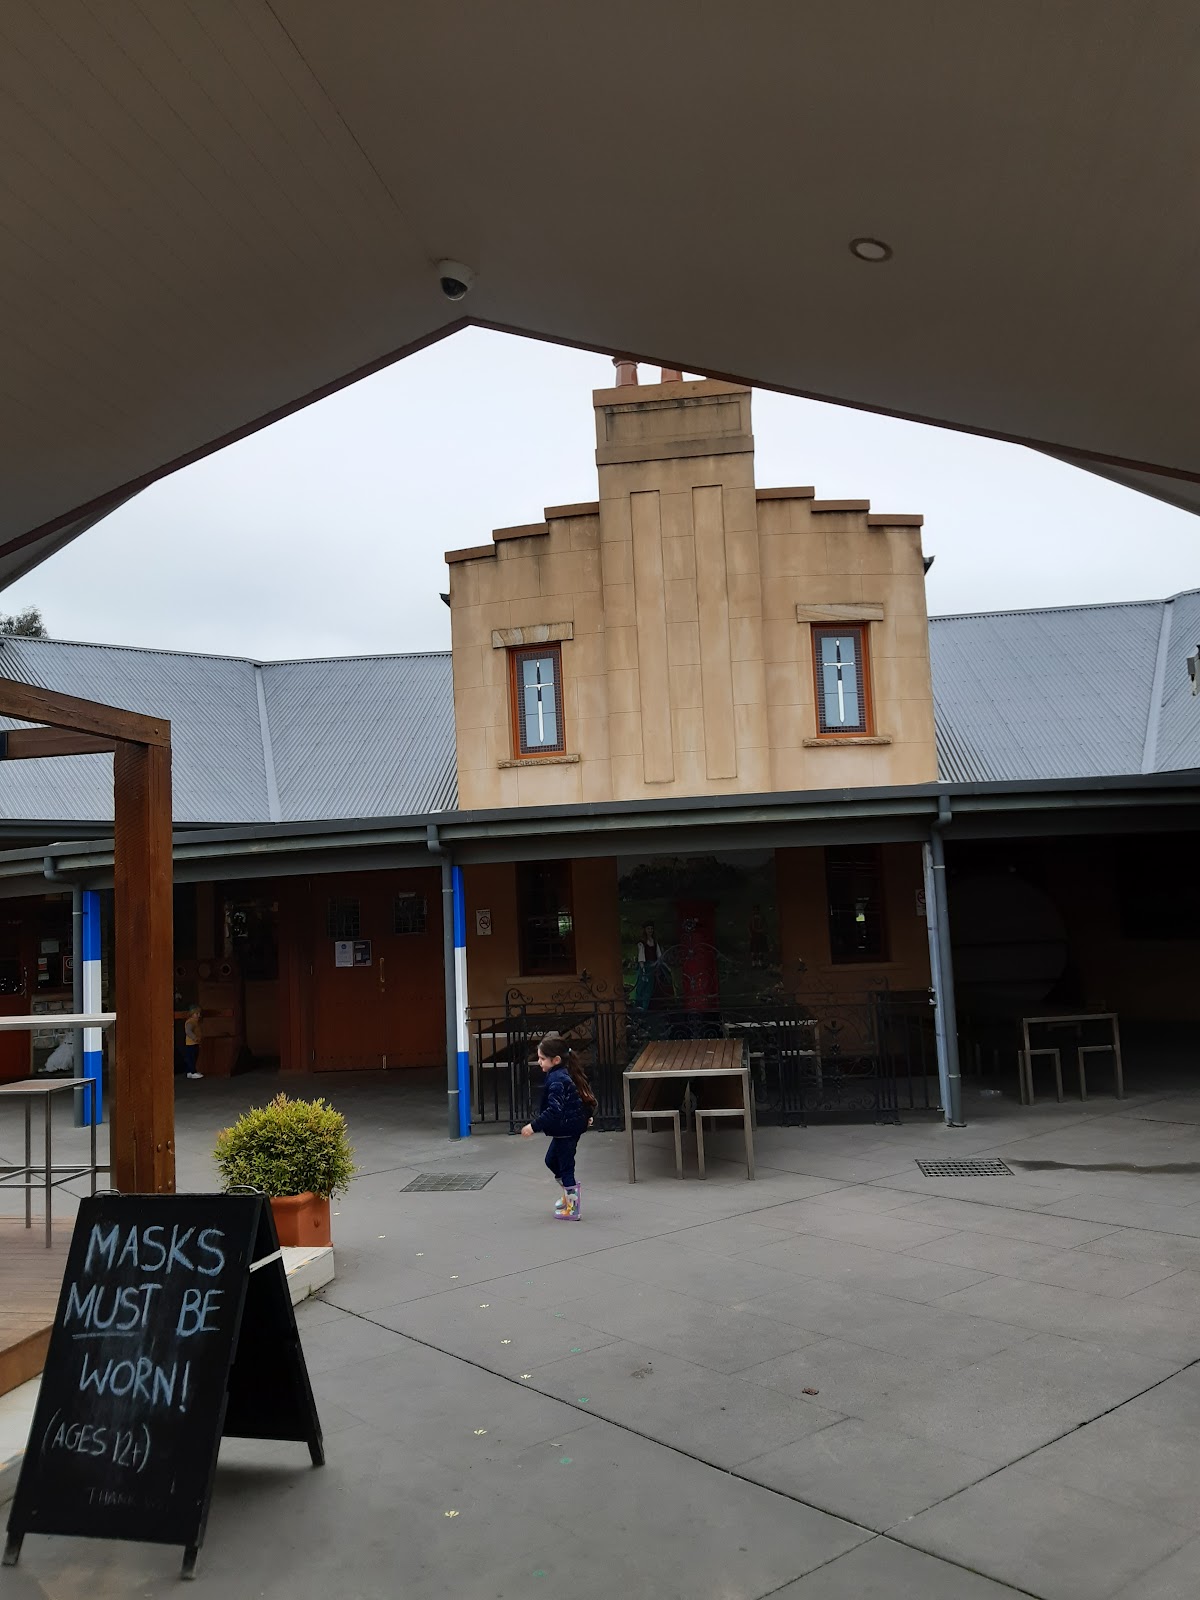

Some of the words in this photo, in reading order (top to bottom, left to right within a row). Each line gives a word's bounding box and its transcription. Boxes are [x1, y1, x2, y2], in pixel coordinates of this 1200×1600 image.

[84, 1223, 226, 1277] MASKS
[63, 1282, 163, 1331] MUST
[175, 1288, 226, 1337] BE
[79, 1352, 191, 1413] WORN!
[41, 1408, 108, 1456] (AGES
[112, 1423, 151, 1473] 12+)
